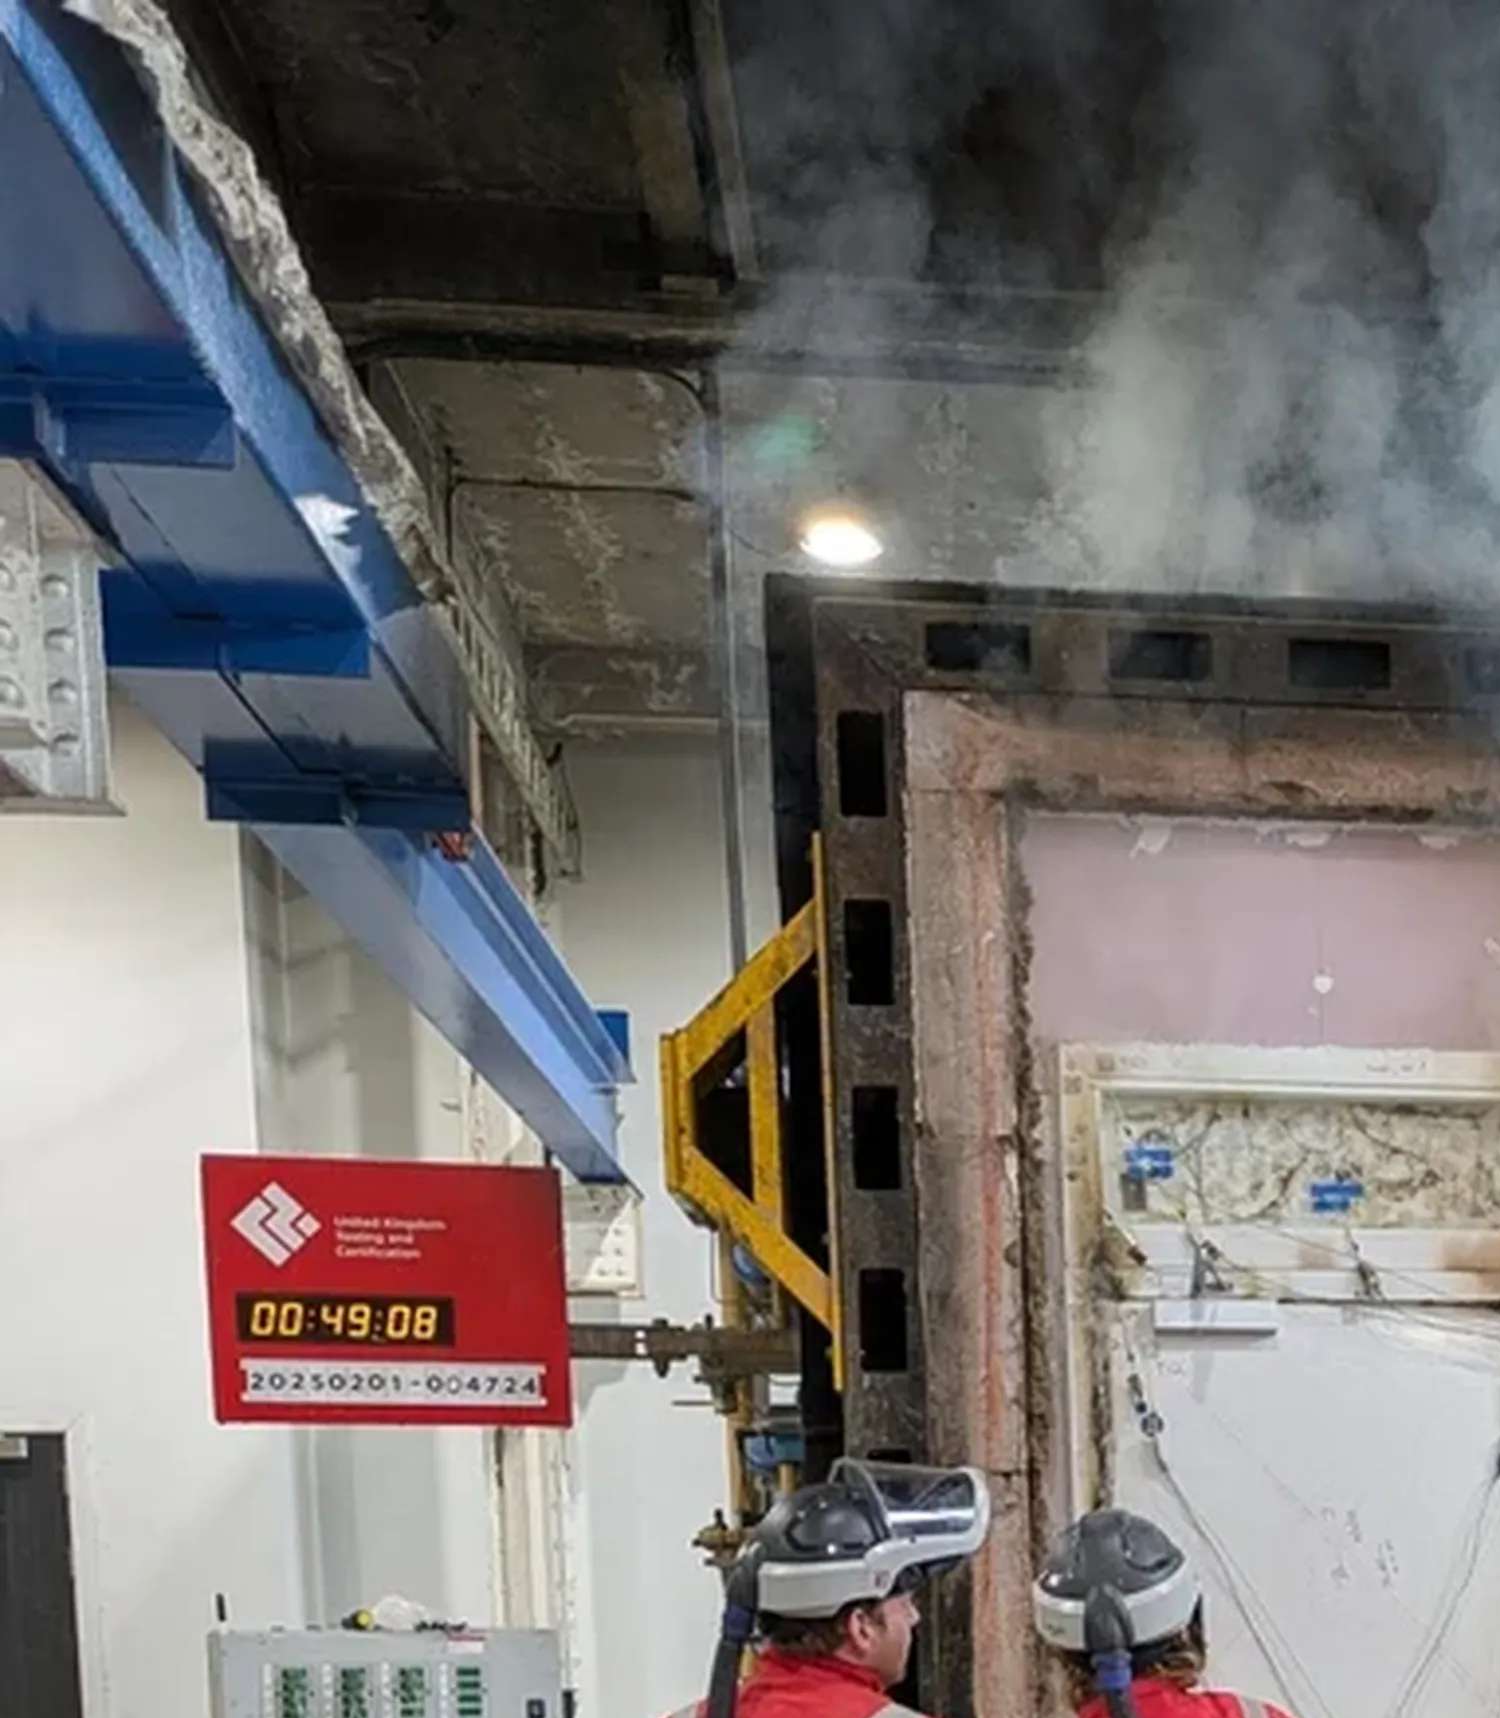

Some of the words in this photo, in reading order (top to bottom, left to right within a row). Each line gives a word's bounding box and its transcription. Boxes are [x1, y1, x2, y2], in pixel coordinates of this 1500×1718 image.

[333, 1216, 379, 1230] United
[383, 1217, 446, 1233] Kingdom
[336, 1230, 384, 1245] Testing
[388, 1231, 414, 1245] and
[335, 1244, 422, 1259] Certification
[250, 1301, 437, 1339] 00:49:08
[250, 1371, 537, 1396] 20250201-004724
